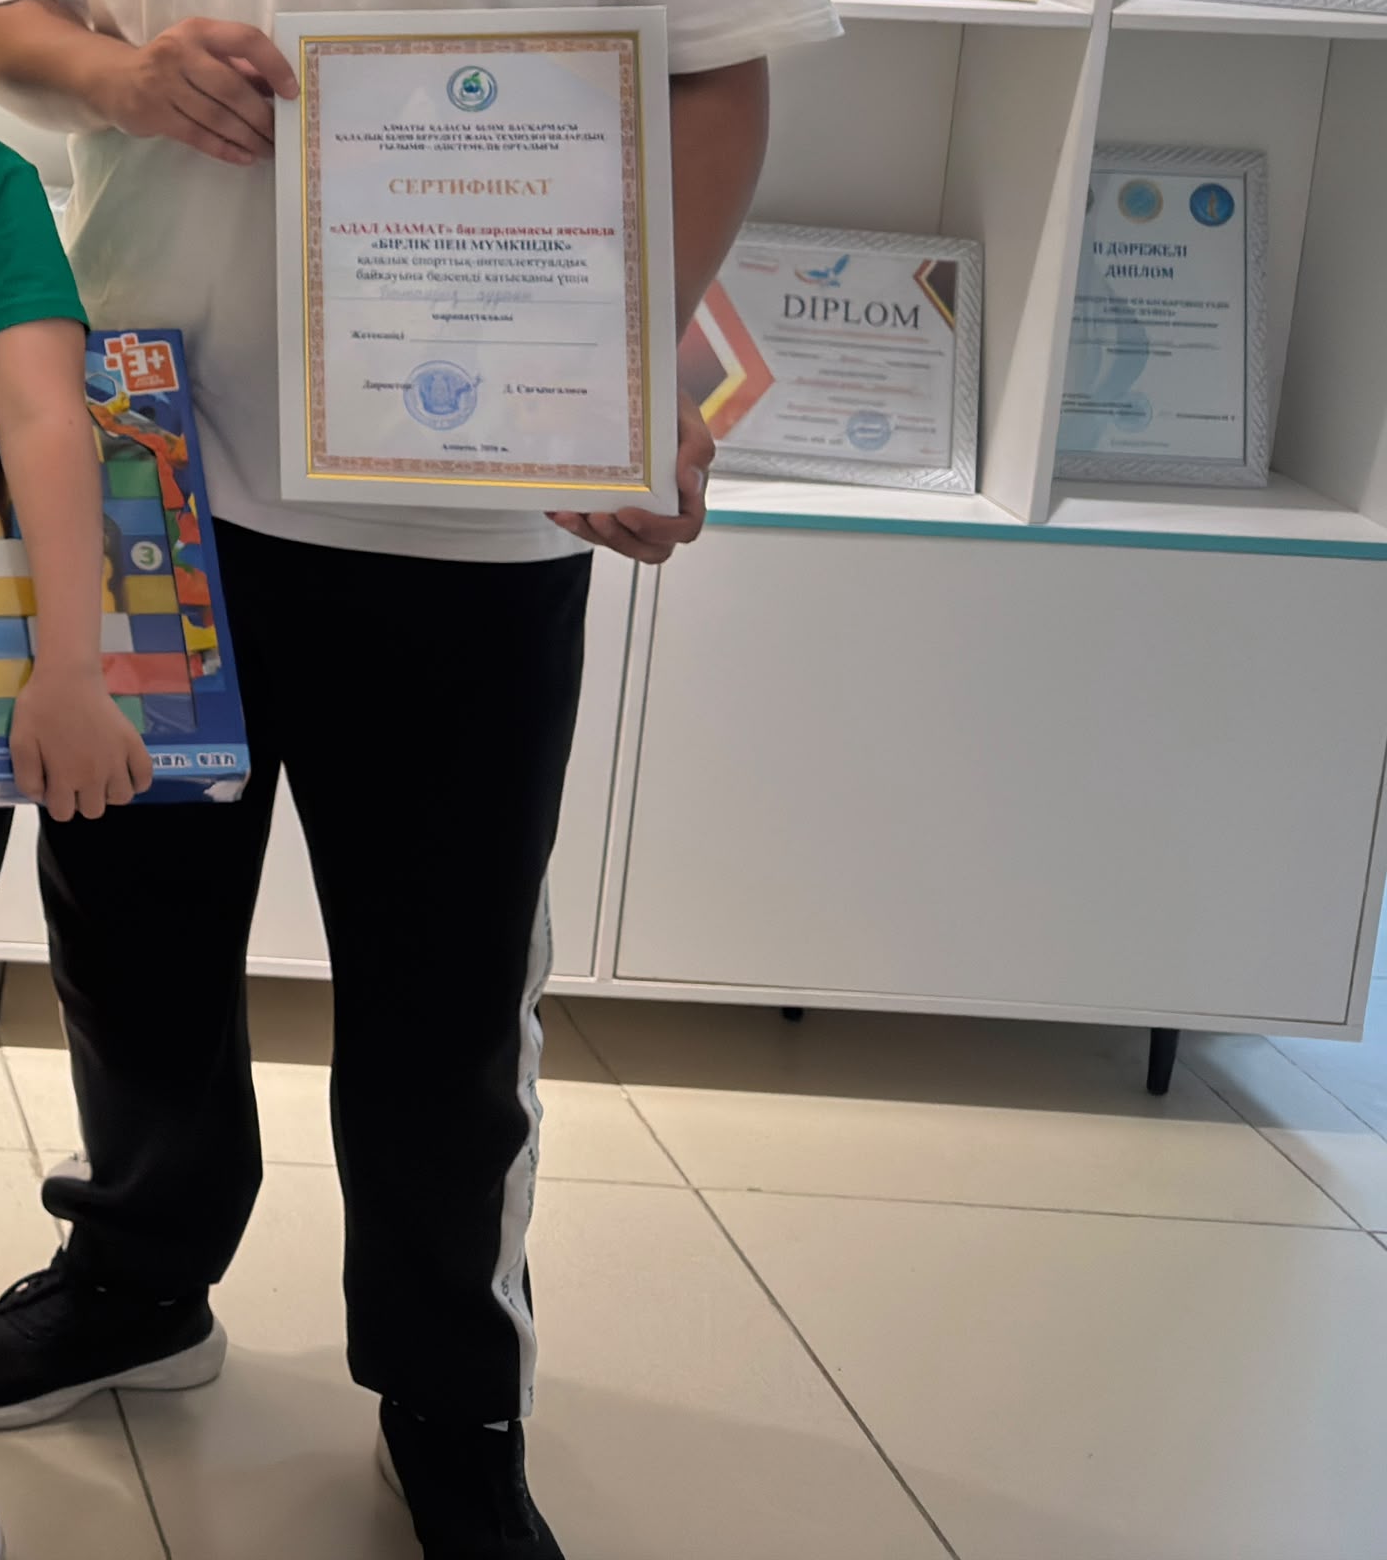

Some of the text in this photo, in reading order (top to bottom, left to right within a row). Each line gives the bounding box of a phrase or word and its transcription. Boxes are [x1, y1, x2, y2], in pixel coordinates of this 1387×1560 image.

[388, 178, 552, 195] СЕРТИФИКАТ
[329, 223, 379, 236] «АДАЛ
[383, 224, 453, 236] АЗАМАТ»
[371, 239, 572, 253] «БІРЛІК ПЕН МҮМКІНДІК»
[1105, 264, 1175, 279] ДИПЛОМ
[783, 293, 921, 329] DIPLOM
[139, 545, 154, 567] 3
